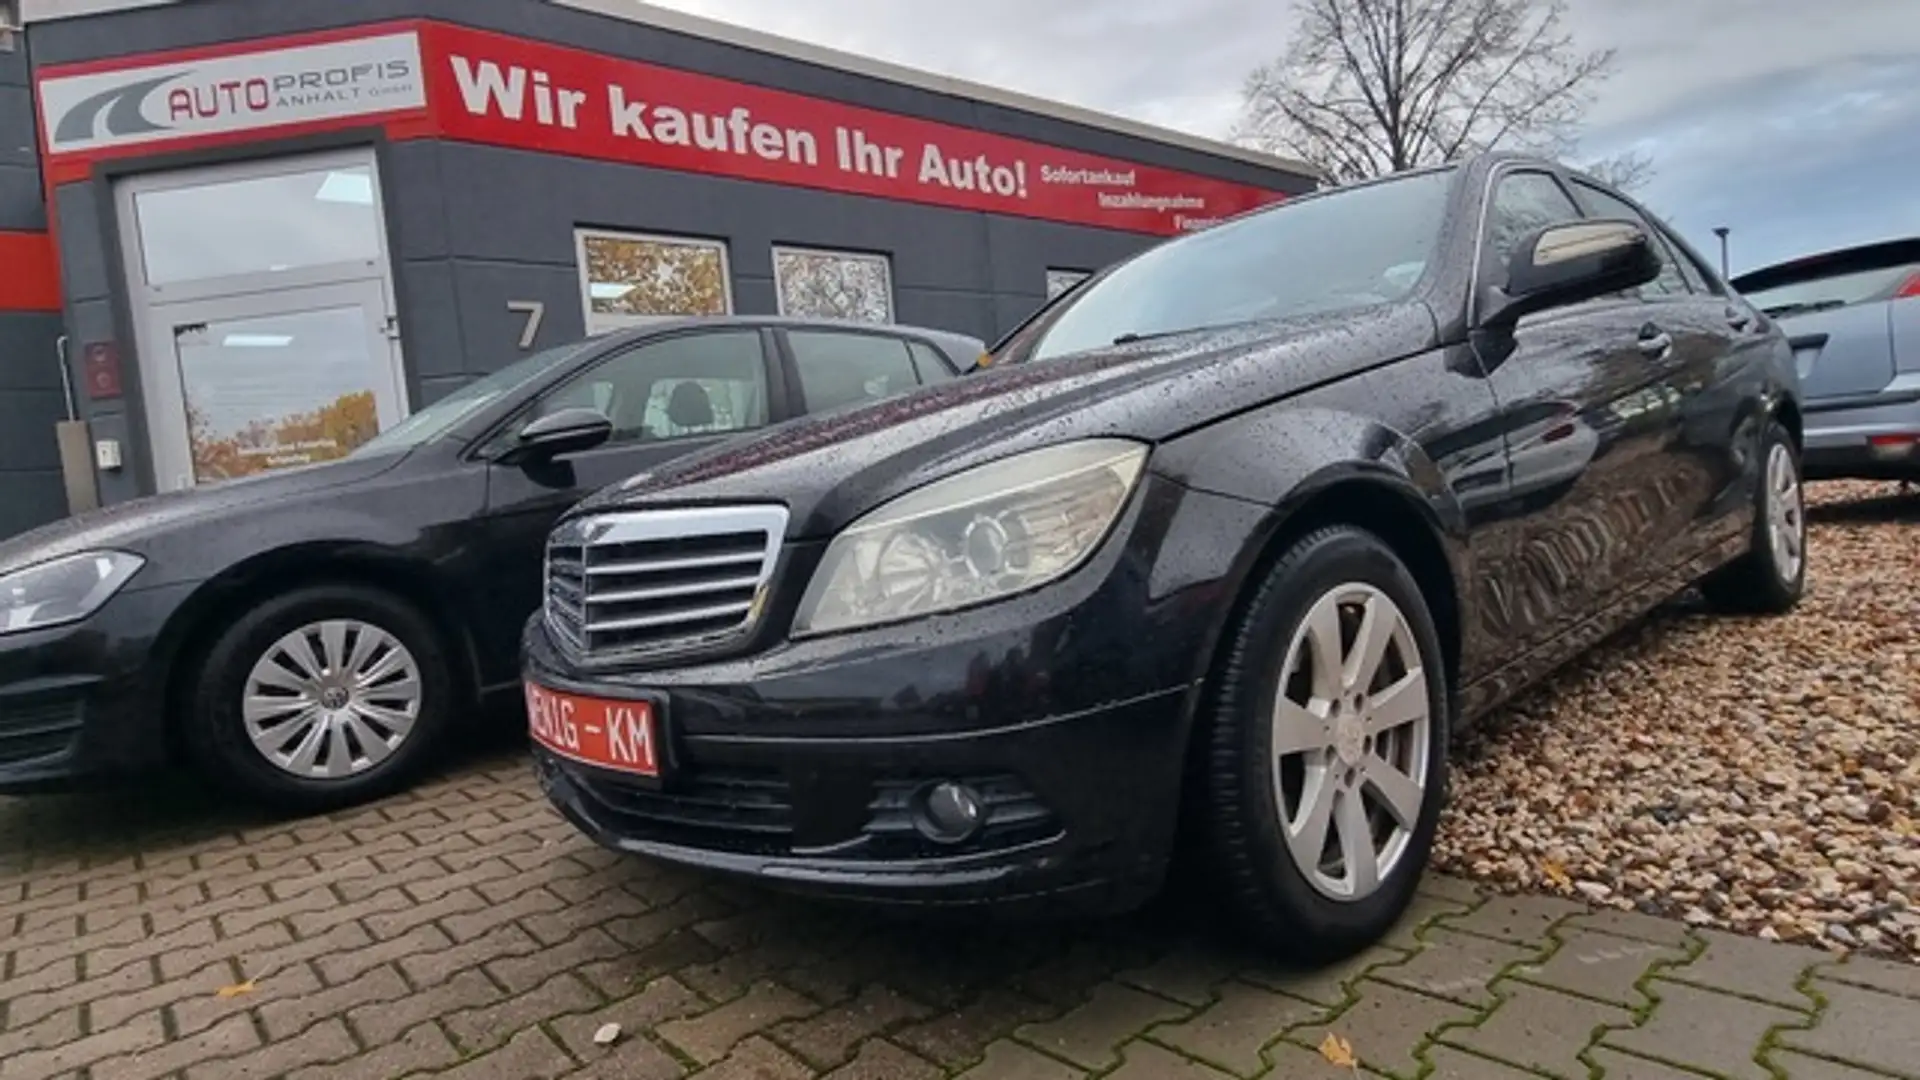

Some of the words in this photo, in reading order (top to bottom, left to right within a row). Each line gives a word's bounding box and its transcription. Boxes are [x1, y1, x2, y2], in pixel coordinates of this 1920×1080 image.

[276, 87, 360, 109] ANHALT
[449, 54, 586, 128] Wir
[608, 83, 817, 166] kaufen
[836, 126, 904, 178] Ihr
[918, 143, 1027, 199] Auto!
[1040, 165, 1136, 187] Sofortankauf
[1098, 191, 1205, 212] Inzahlungnahme
[506, 300, 544, 348] 7
